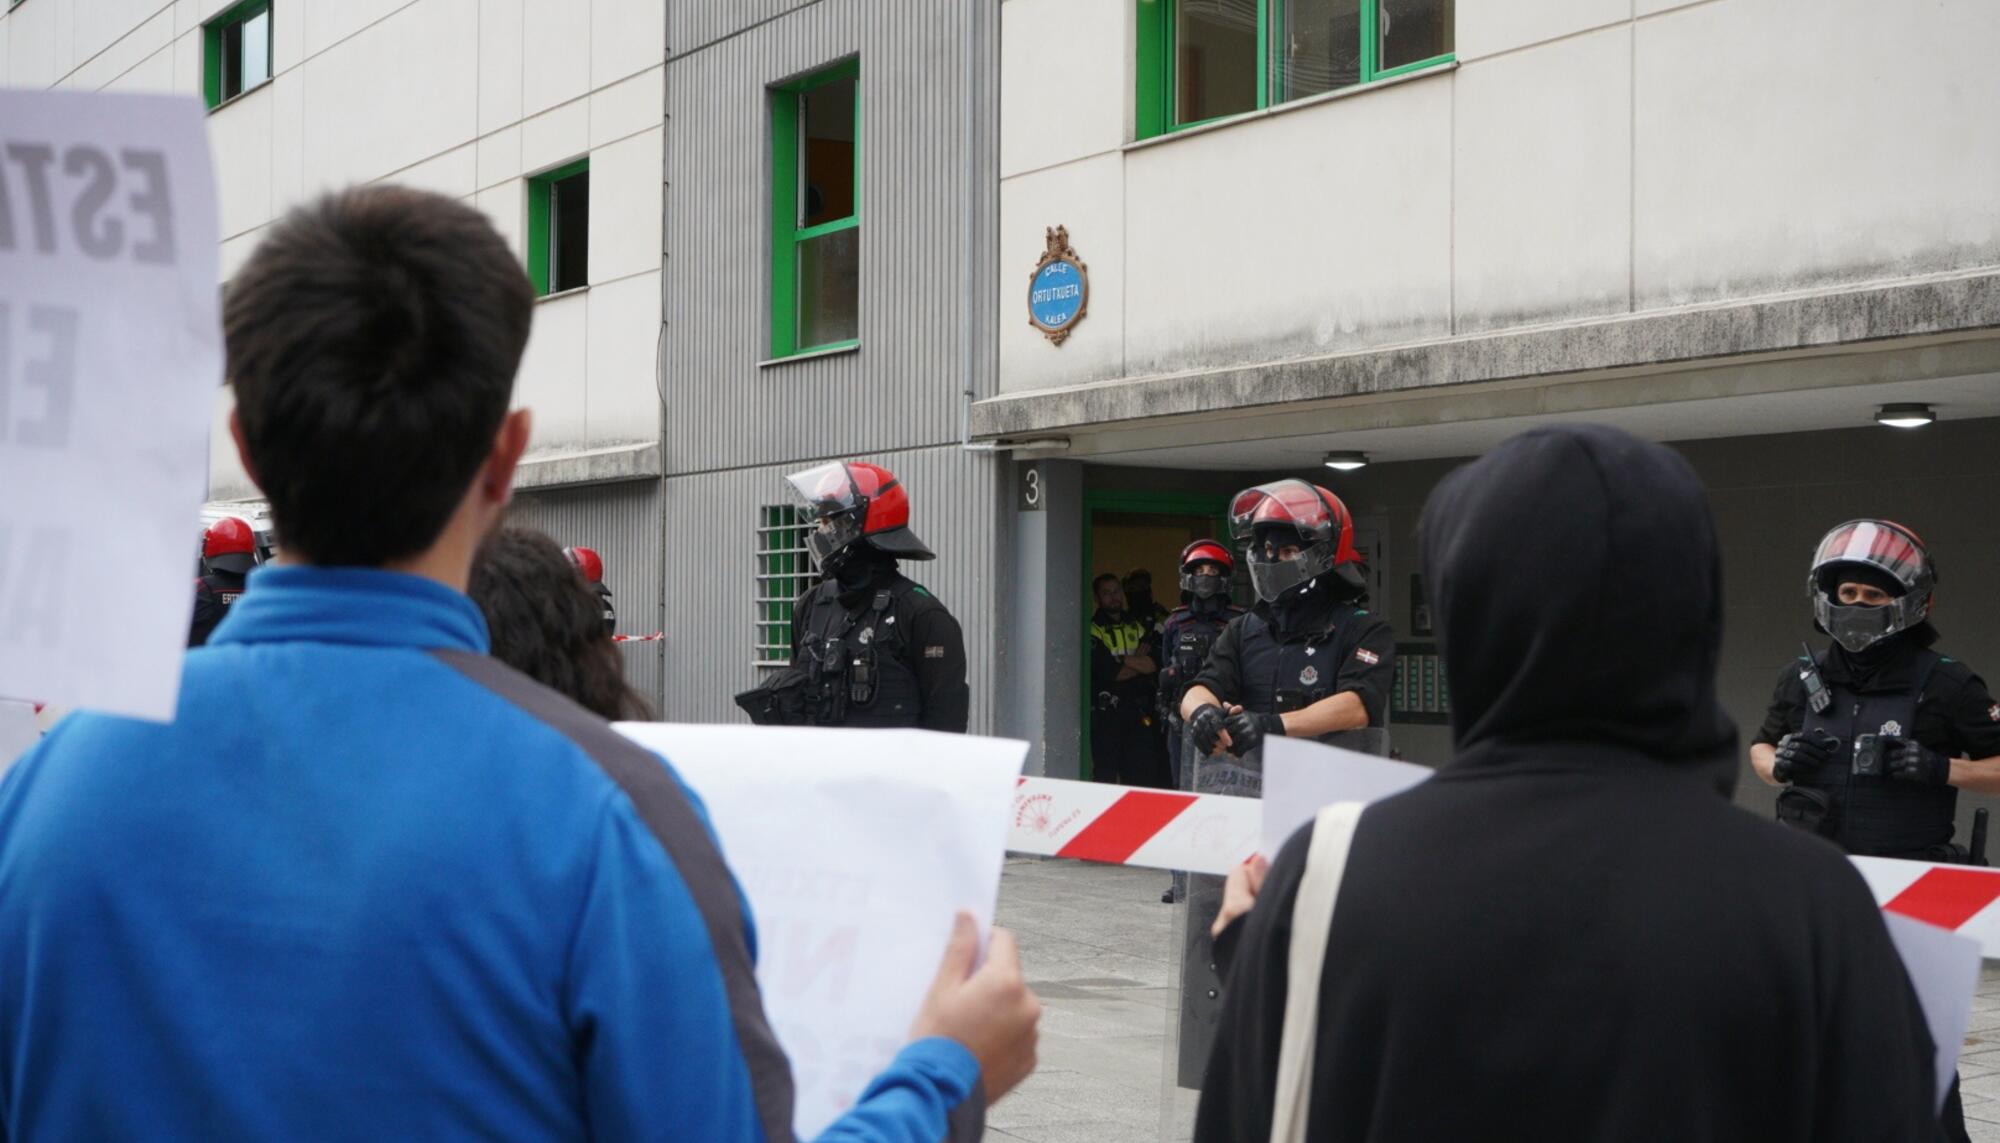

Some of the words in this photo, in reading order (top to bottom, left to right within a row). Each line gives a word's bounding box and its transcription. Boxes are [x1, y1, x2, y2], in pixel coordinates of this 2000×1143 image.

[1045, 262, 1068, 276] CALLE
[1033, 284, 1079, 304] ORTUTXUETA
[1045, 312, 1067, 325] KALEA
[1026, 469, 1038, 504] 3
